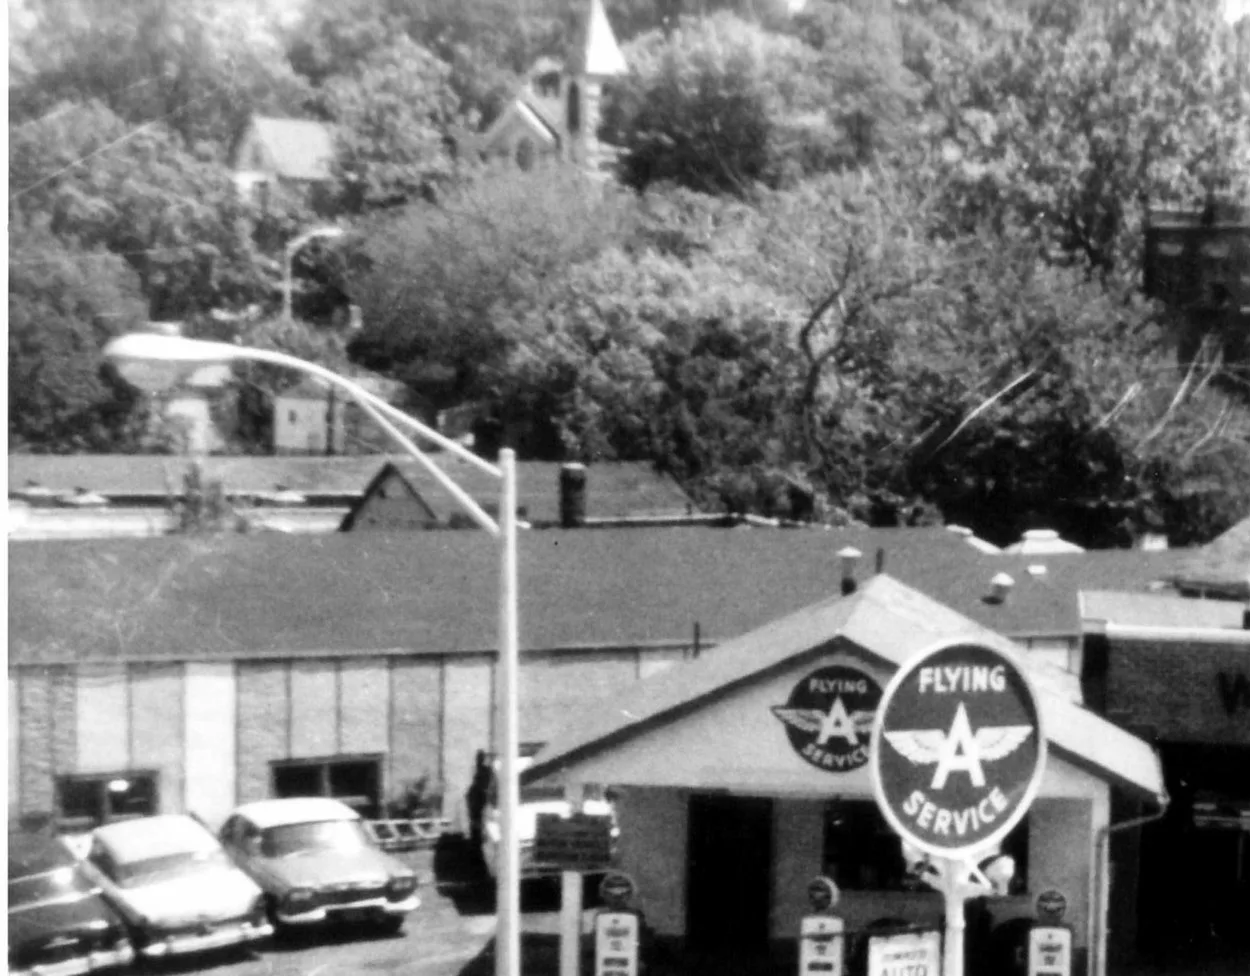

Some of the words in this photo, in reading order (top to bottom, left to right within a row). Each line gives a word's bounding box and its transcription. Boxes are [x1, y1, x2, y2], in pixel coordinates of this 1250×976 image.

[808, 678, 868, 694] FLYING
[919, 665, 1006, 693] FLYING
[816, 695, 859, 746] A
[802, 742, 870, 768] SERVIC
[930, 700, 987, 790] A
[902, 786, 1009, 837] SERVICE
